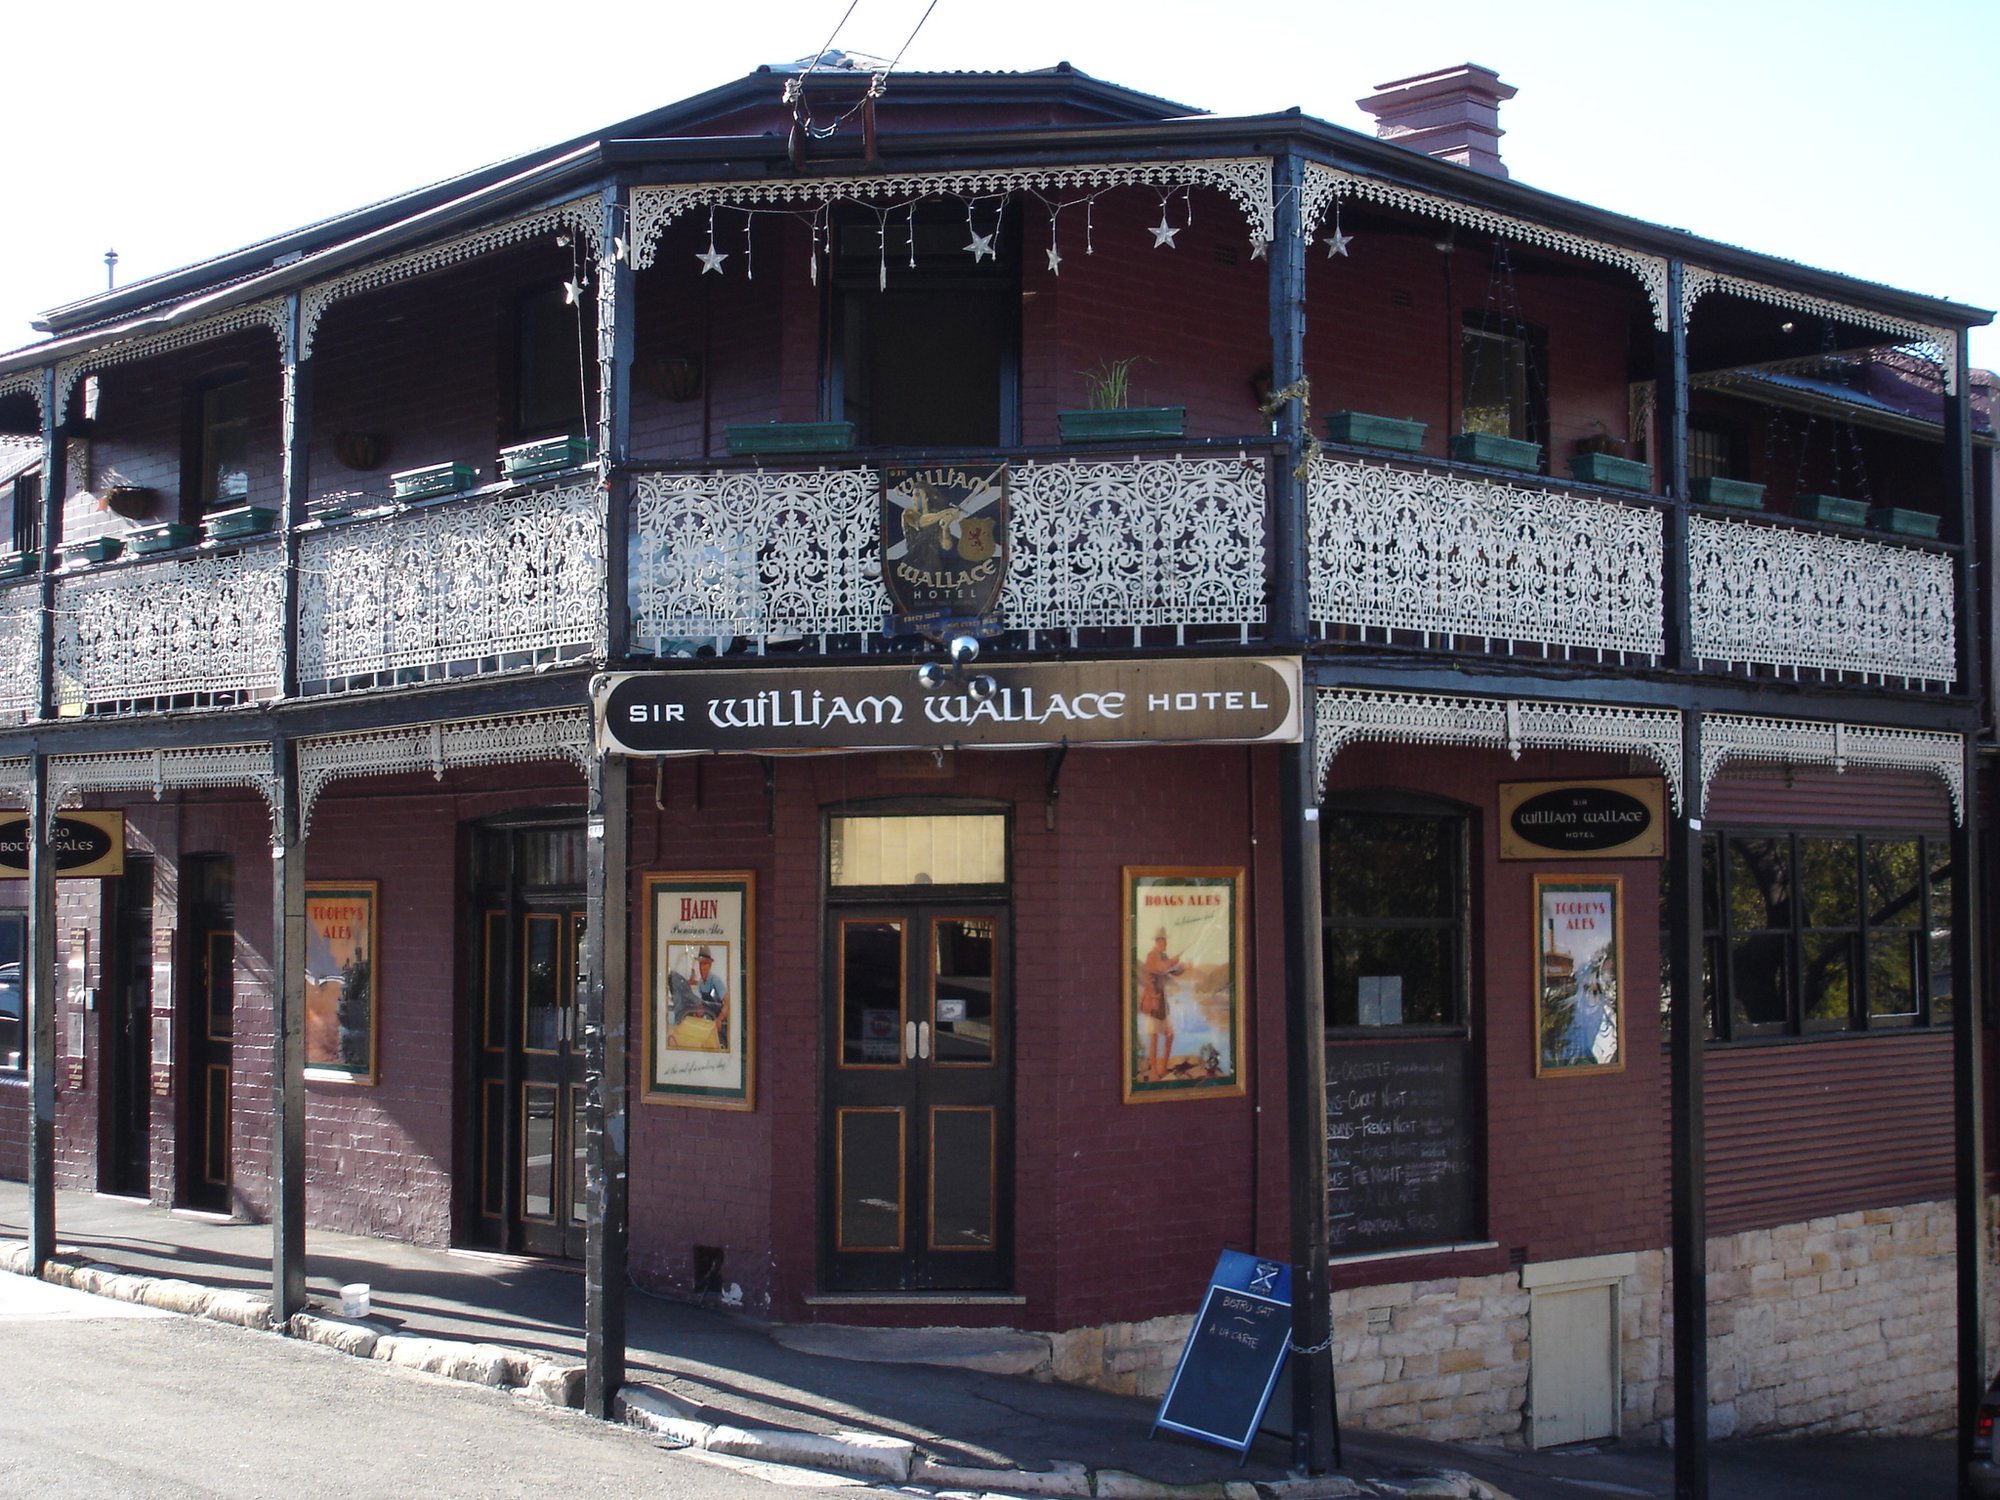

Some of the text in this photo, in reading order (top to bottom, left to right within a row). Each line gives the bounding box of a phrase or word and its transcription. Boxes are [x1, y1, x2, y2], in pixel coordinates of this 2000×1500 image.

[914, 589, 976, 599] HOTEL
[628, 703, 684, 724] SIR
[1147, 690, 1268, 712] HOTEL
[1145, 895, 1221, 906] BOAGS ALES
[680, 898, 718, 922] HAHN
[1566, 918, 1595, 930] ALES
[323, 926, 352, 940] ALES
